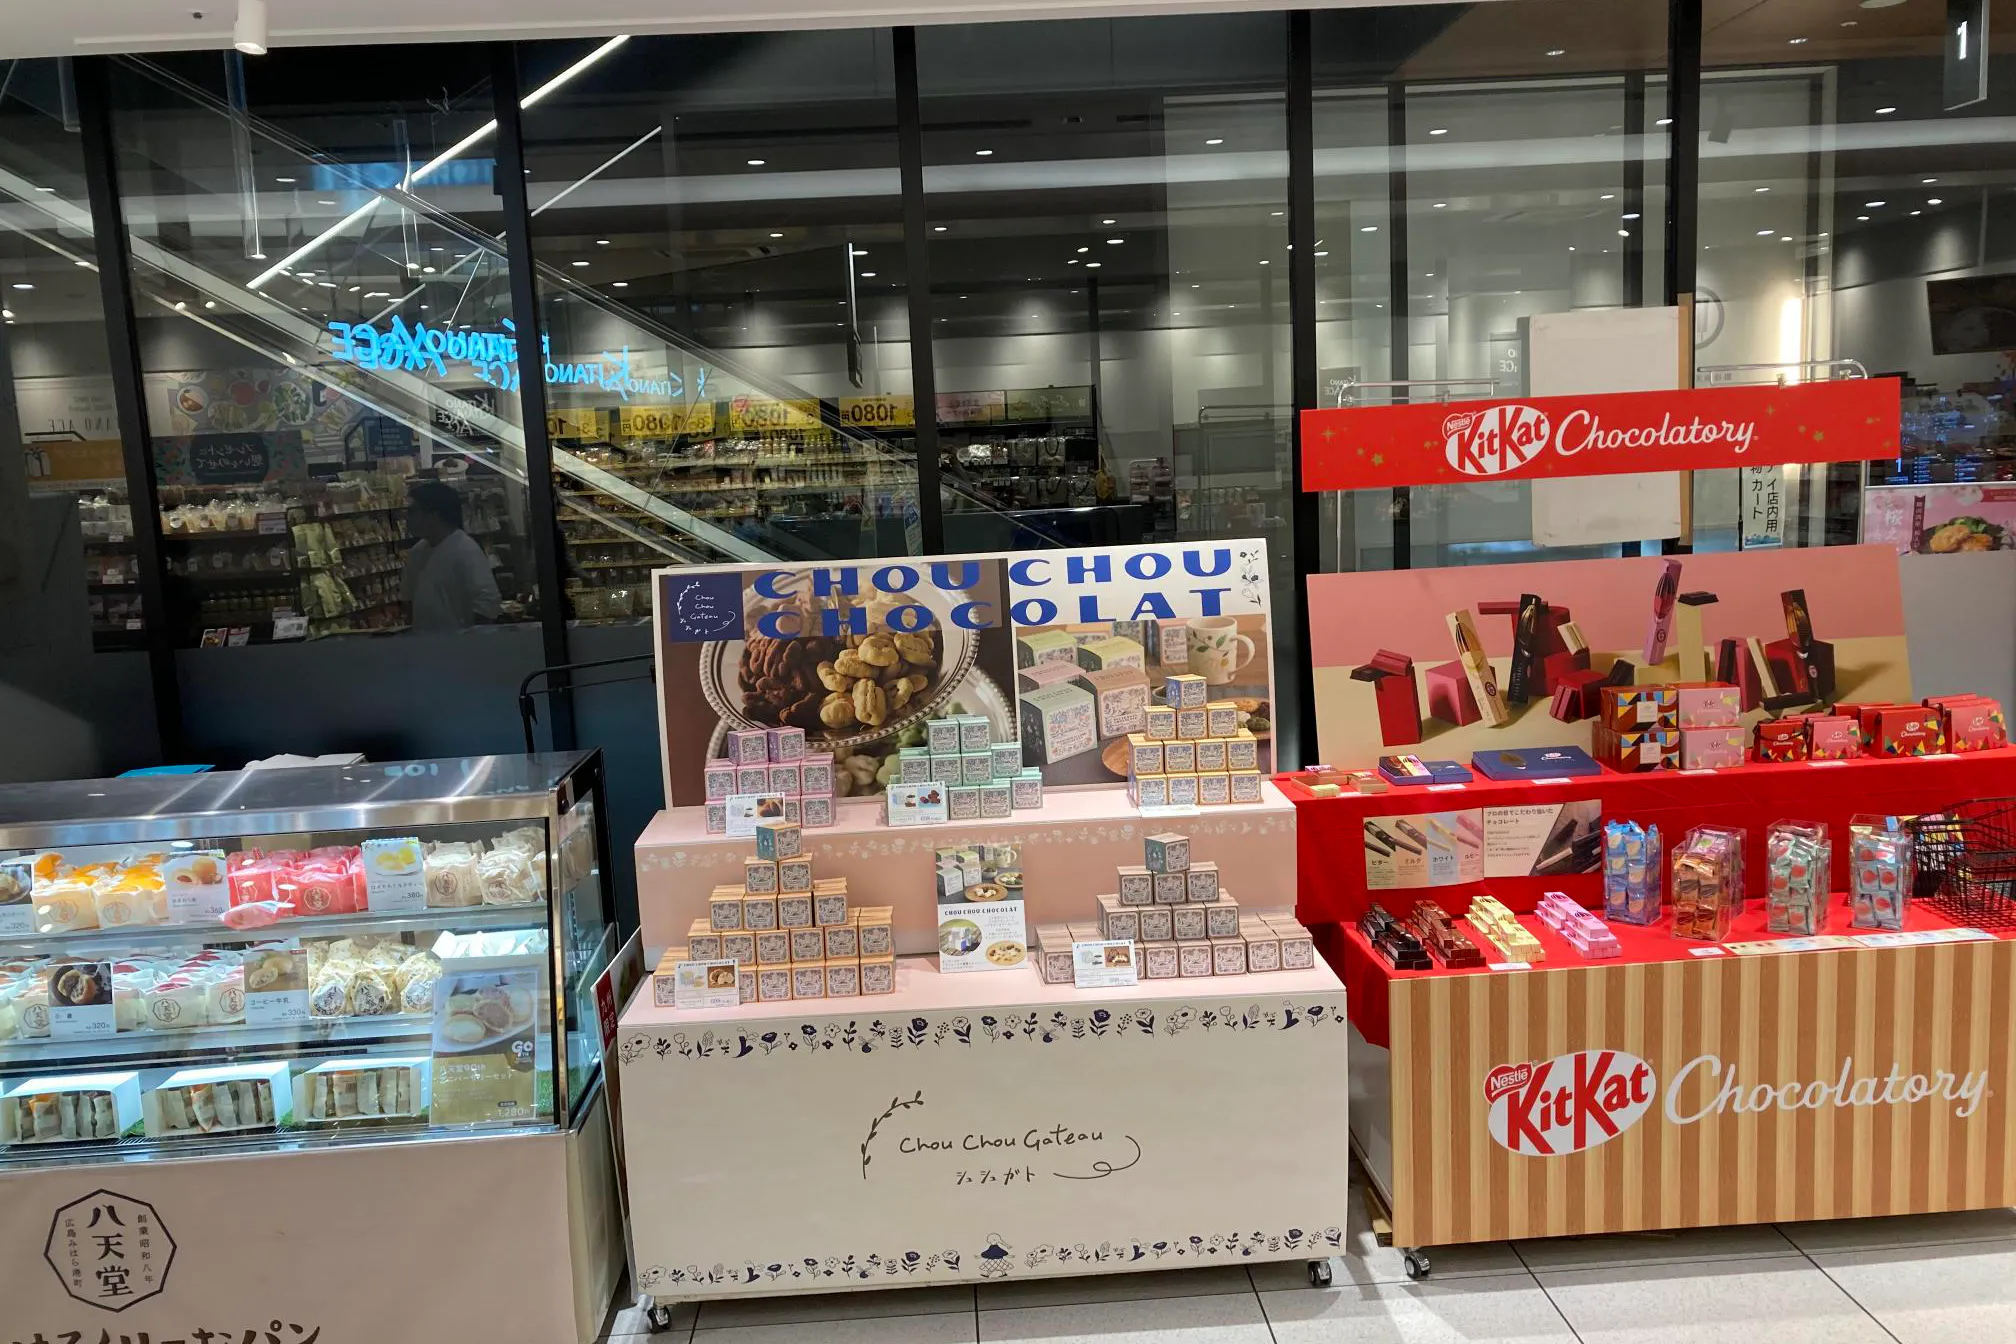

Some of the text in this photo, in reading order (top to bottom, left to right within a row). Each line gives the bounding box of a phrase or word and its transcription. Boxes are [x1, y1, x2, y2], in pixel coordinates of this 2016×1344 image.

[1956, 20, 1968, 61] 1
[1457, 406, 1755, 474] KitKat Chocolatory
[754, 548, 1234, 600] CHOU CHOU
[757, 587, 1232, 640] CHOCOLAT
[1507, 1051, 1989, 1155] KitKat Chocolatory
[899, 1123, 1103, 1154] Chou Chou Gateau
[85, 1203, 135, 1298] 八天堂
